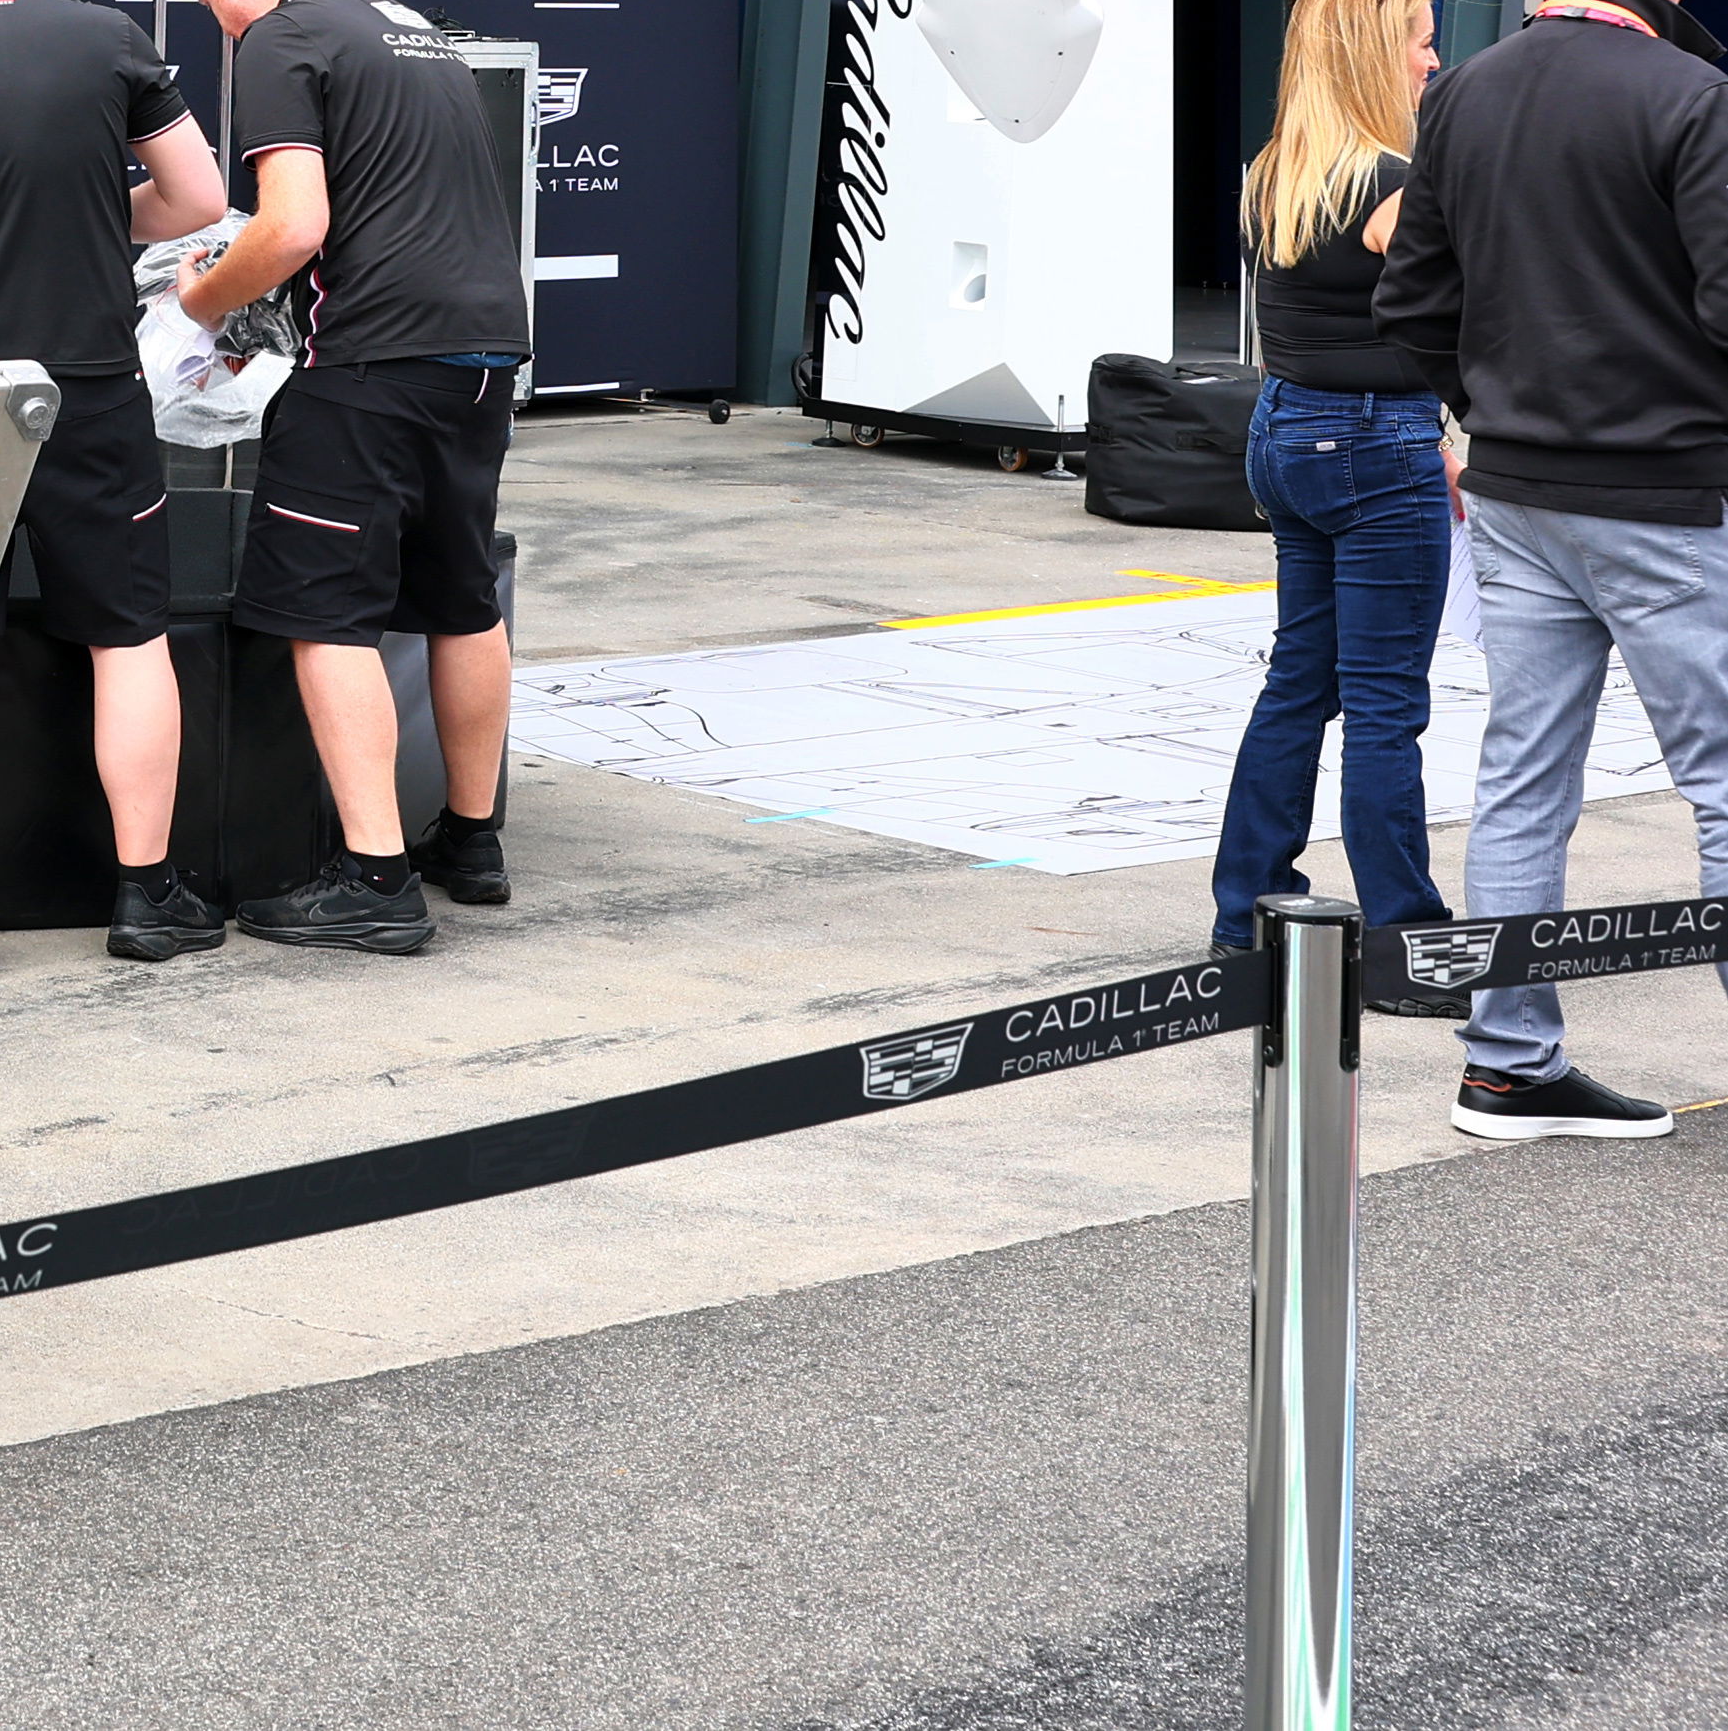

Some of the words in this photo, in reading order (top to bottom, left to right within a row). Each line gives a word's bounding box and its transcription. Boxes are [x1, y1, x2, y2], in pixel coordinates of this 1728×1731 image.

[565, 177, 619, 192] TEAM
[1531, 903, 1725, 948] CADILLAC
[1527, 955, 1633, 980] FORMULA
[1659, 943, 1716, 965] TEAM
[1005, 967, 1223, 1043] CADILLAC
[1001, 1036, 1123, 1078] FORMULA
[1153, 1011, 1220, 1043] TEAM
